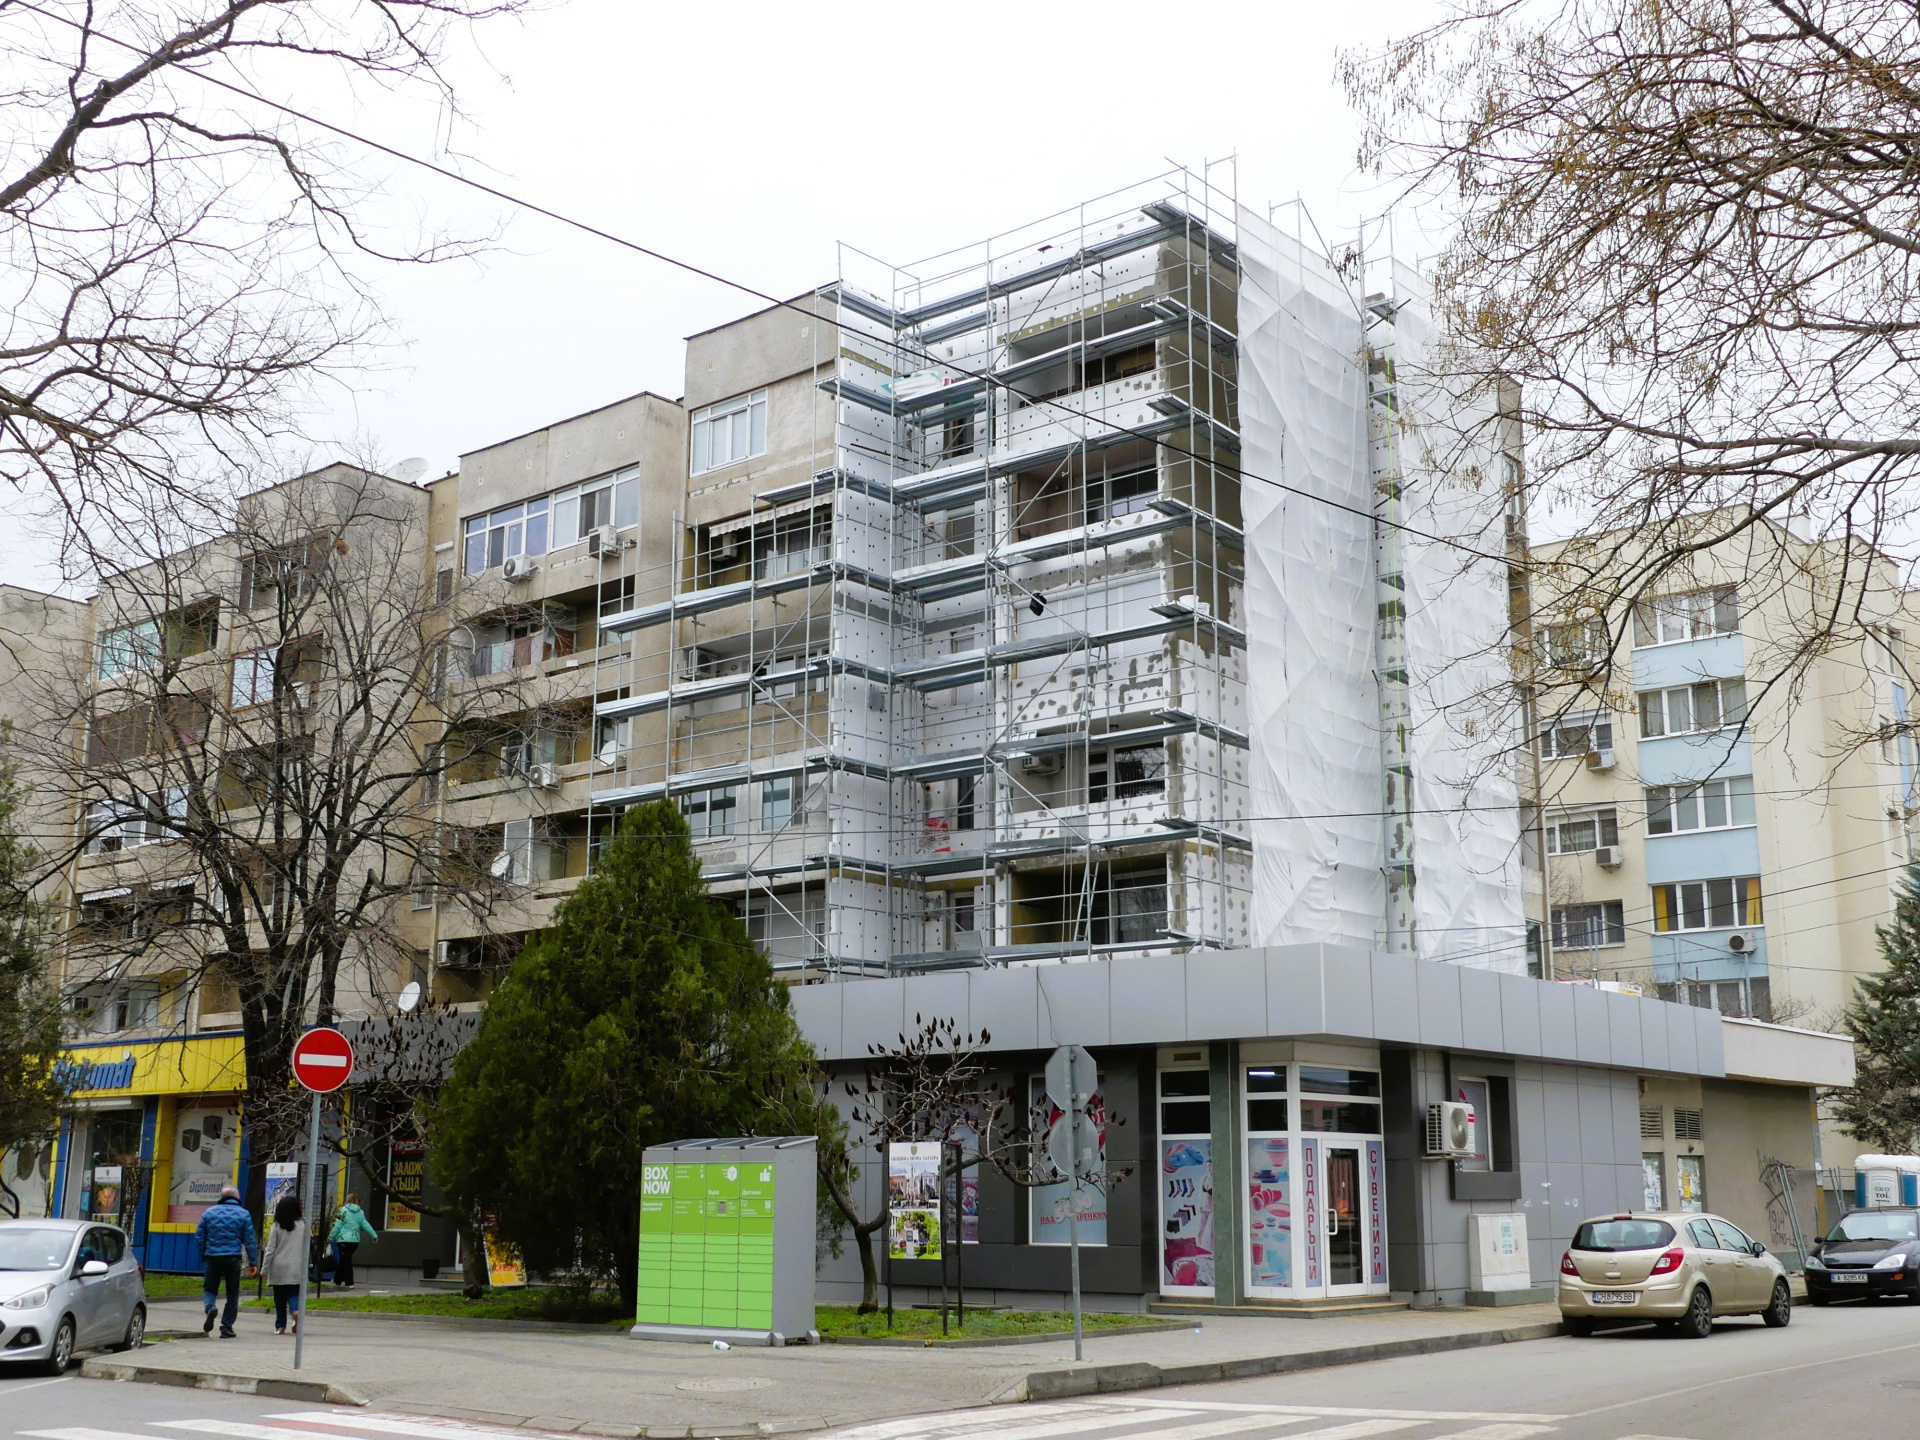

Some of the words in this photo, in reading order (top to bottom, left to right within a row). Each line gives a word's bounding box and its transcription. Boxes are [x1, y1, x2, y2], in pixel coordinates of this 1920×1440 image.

[644, 1166, 669, 1180] BOX
[189, 1181, 223, 1195] Diplomat
[643, 1180, 671, 1195] NOW
[1040, 1215, 1056, 1224] НАД
[1305, 1147, 1317, 1280] ПОДАРЪЦИ
[1370, 1150, 1381, 1276] СУВЕНИРИ
